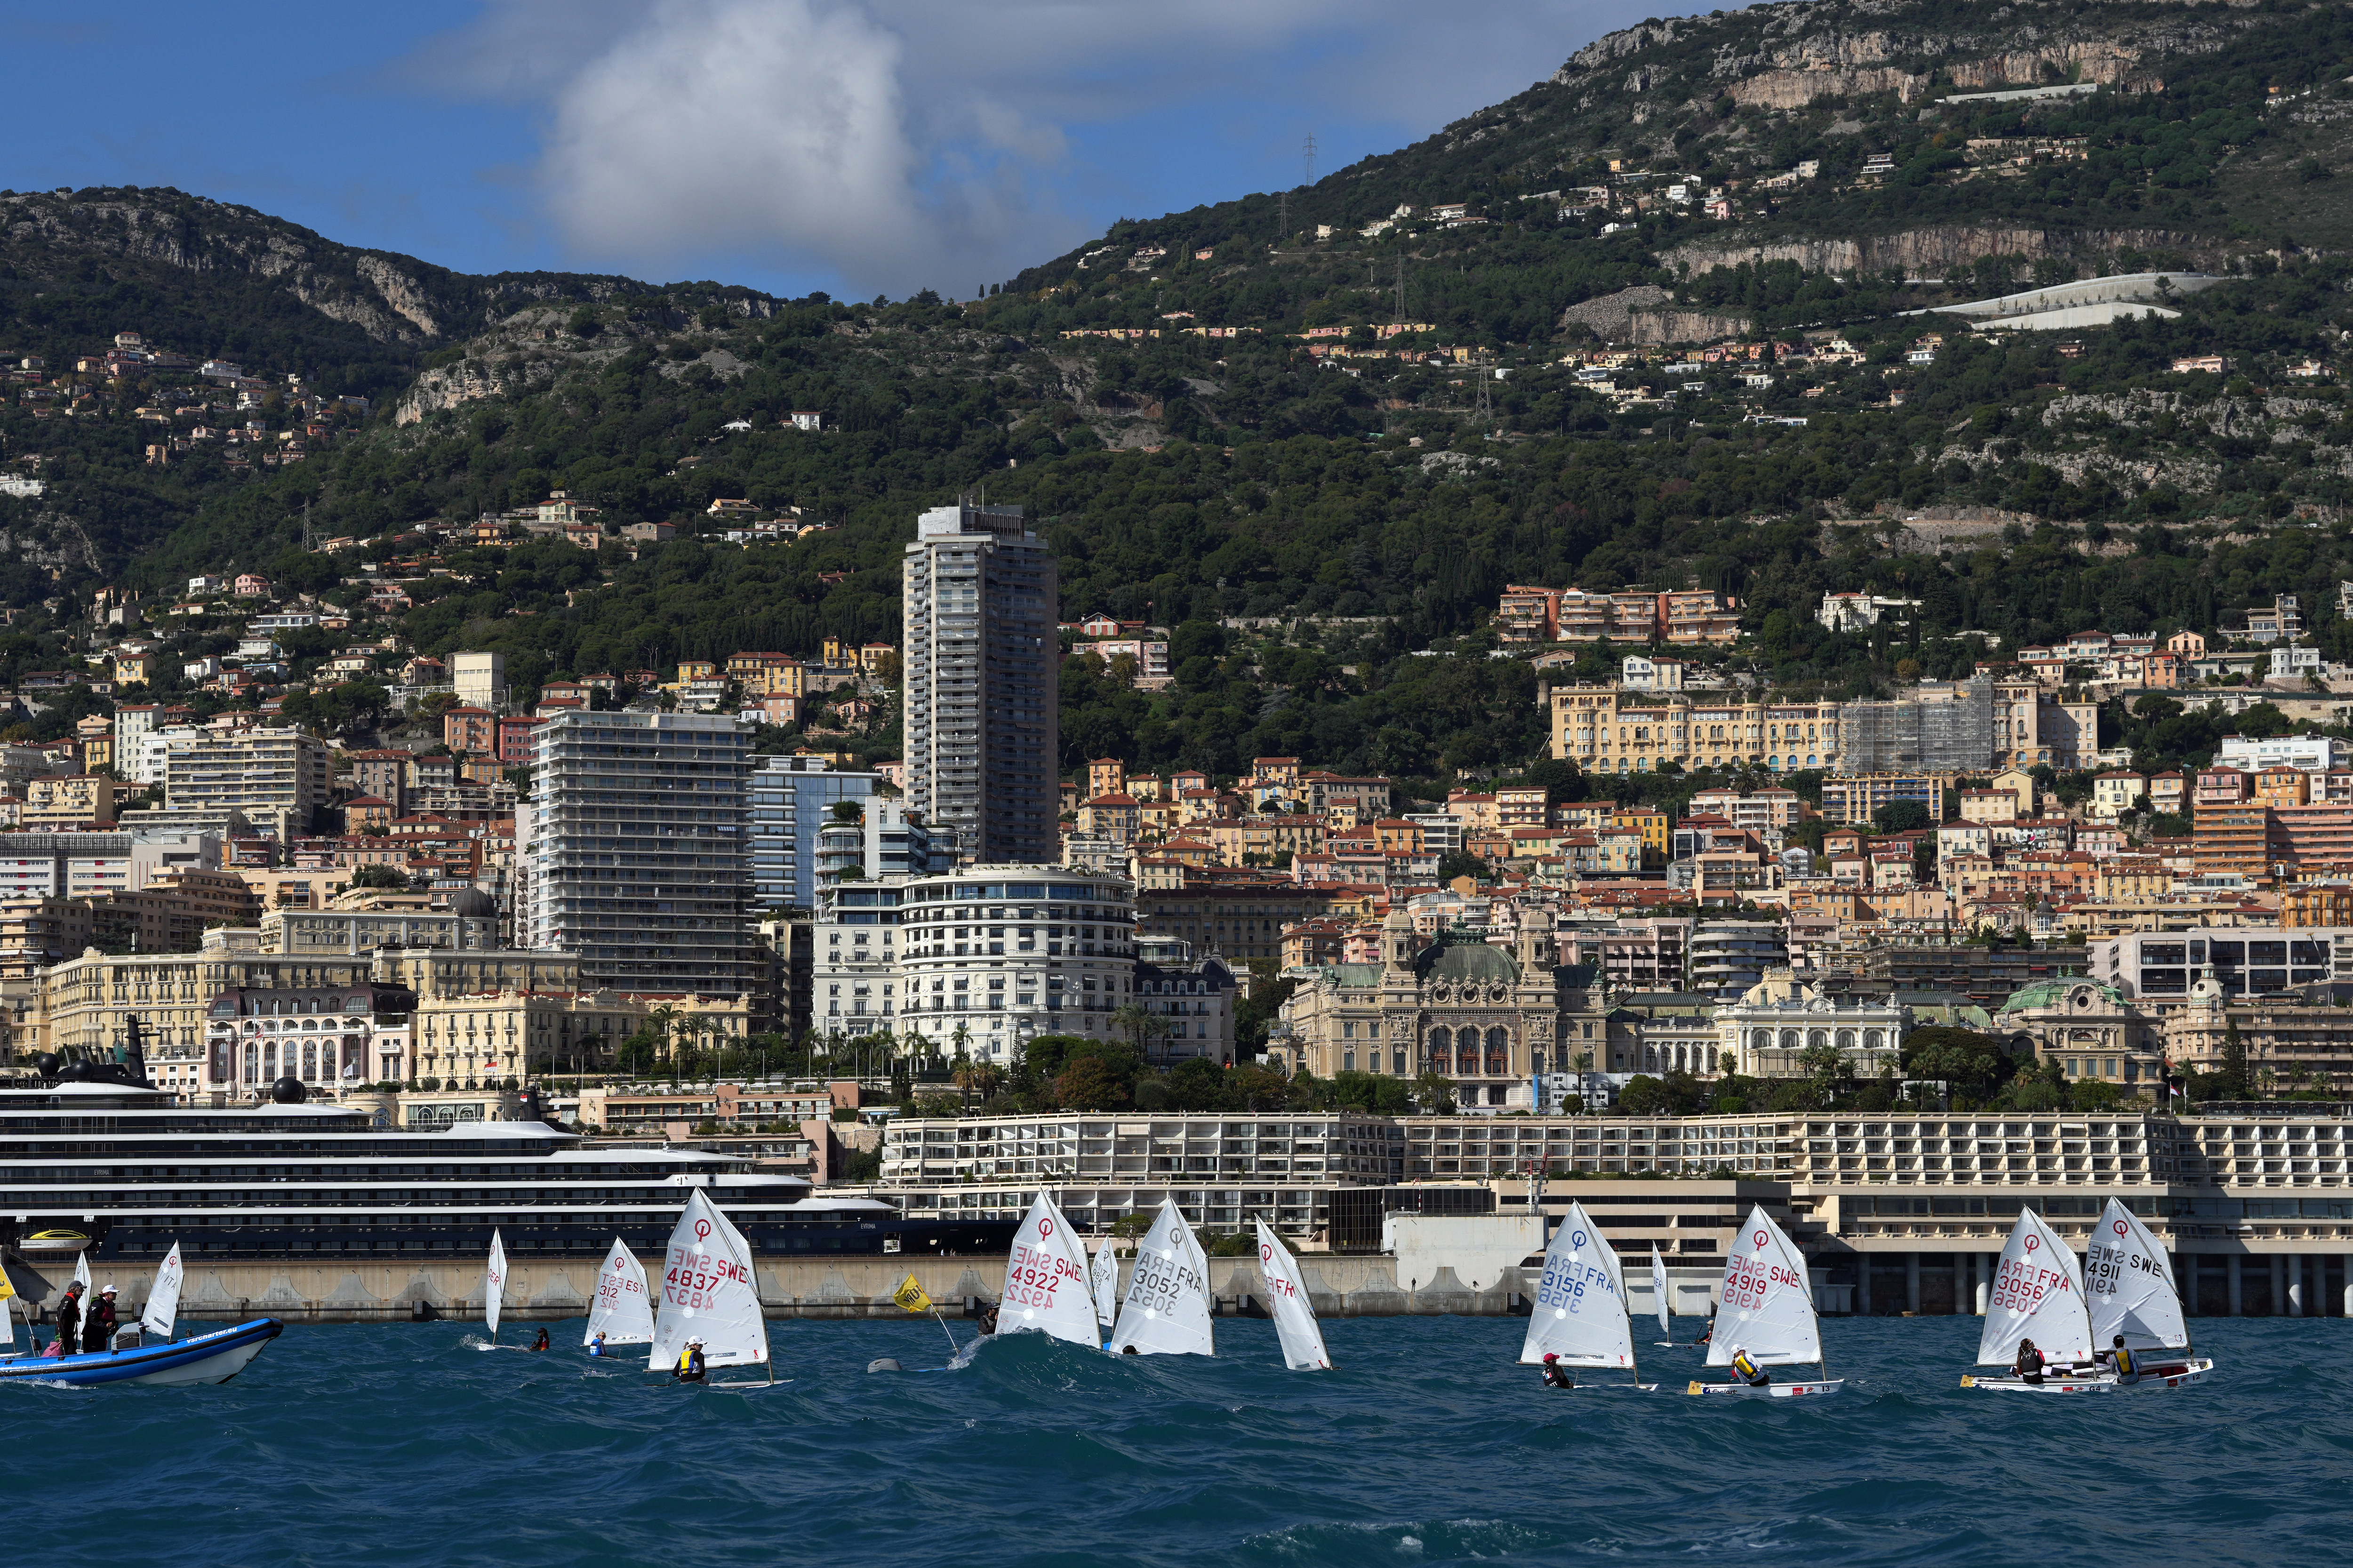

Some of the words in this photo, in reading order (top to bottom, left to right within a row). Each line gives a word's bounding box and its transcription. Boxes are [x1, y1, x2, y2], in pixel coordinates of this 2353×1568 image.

[488, 1268, 500, 1286] GER
[716, 1259, 748, 1284] SWE
[1055, 1258, 1082, 1282] SWE
[1769, 1266, 1800, 1288] SWE
[2088, 1261, 2121, 1280] 4911
[2130, 1254, 2162, 1278] SWE
[164, 1275, 176, 1290] ITA
[599, 1285, 618, 1298] 312
[666, 1267, 720, 1292] 4837
[1011, 1266, 1059, 1293] 4922
[1135, 1268, 1180, 1300] 3052
[1176, 1266, 1201, 1293] FRA
[1543, 1271, 1585, 1297] 3156
[1585, 1267, 1614, 1294] FRA
[1727, 1272, 1767, 1295] 4919
[1998, 1275, 2044, 1300] 3056
[2038, 1269, 2069, 1292] FRA
[186, 1327, 238, 1344] vsrcharter.eu
